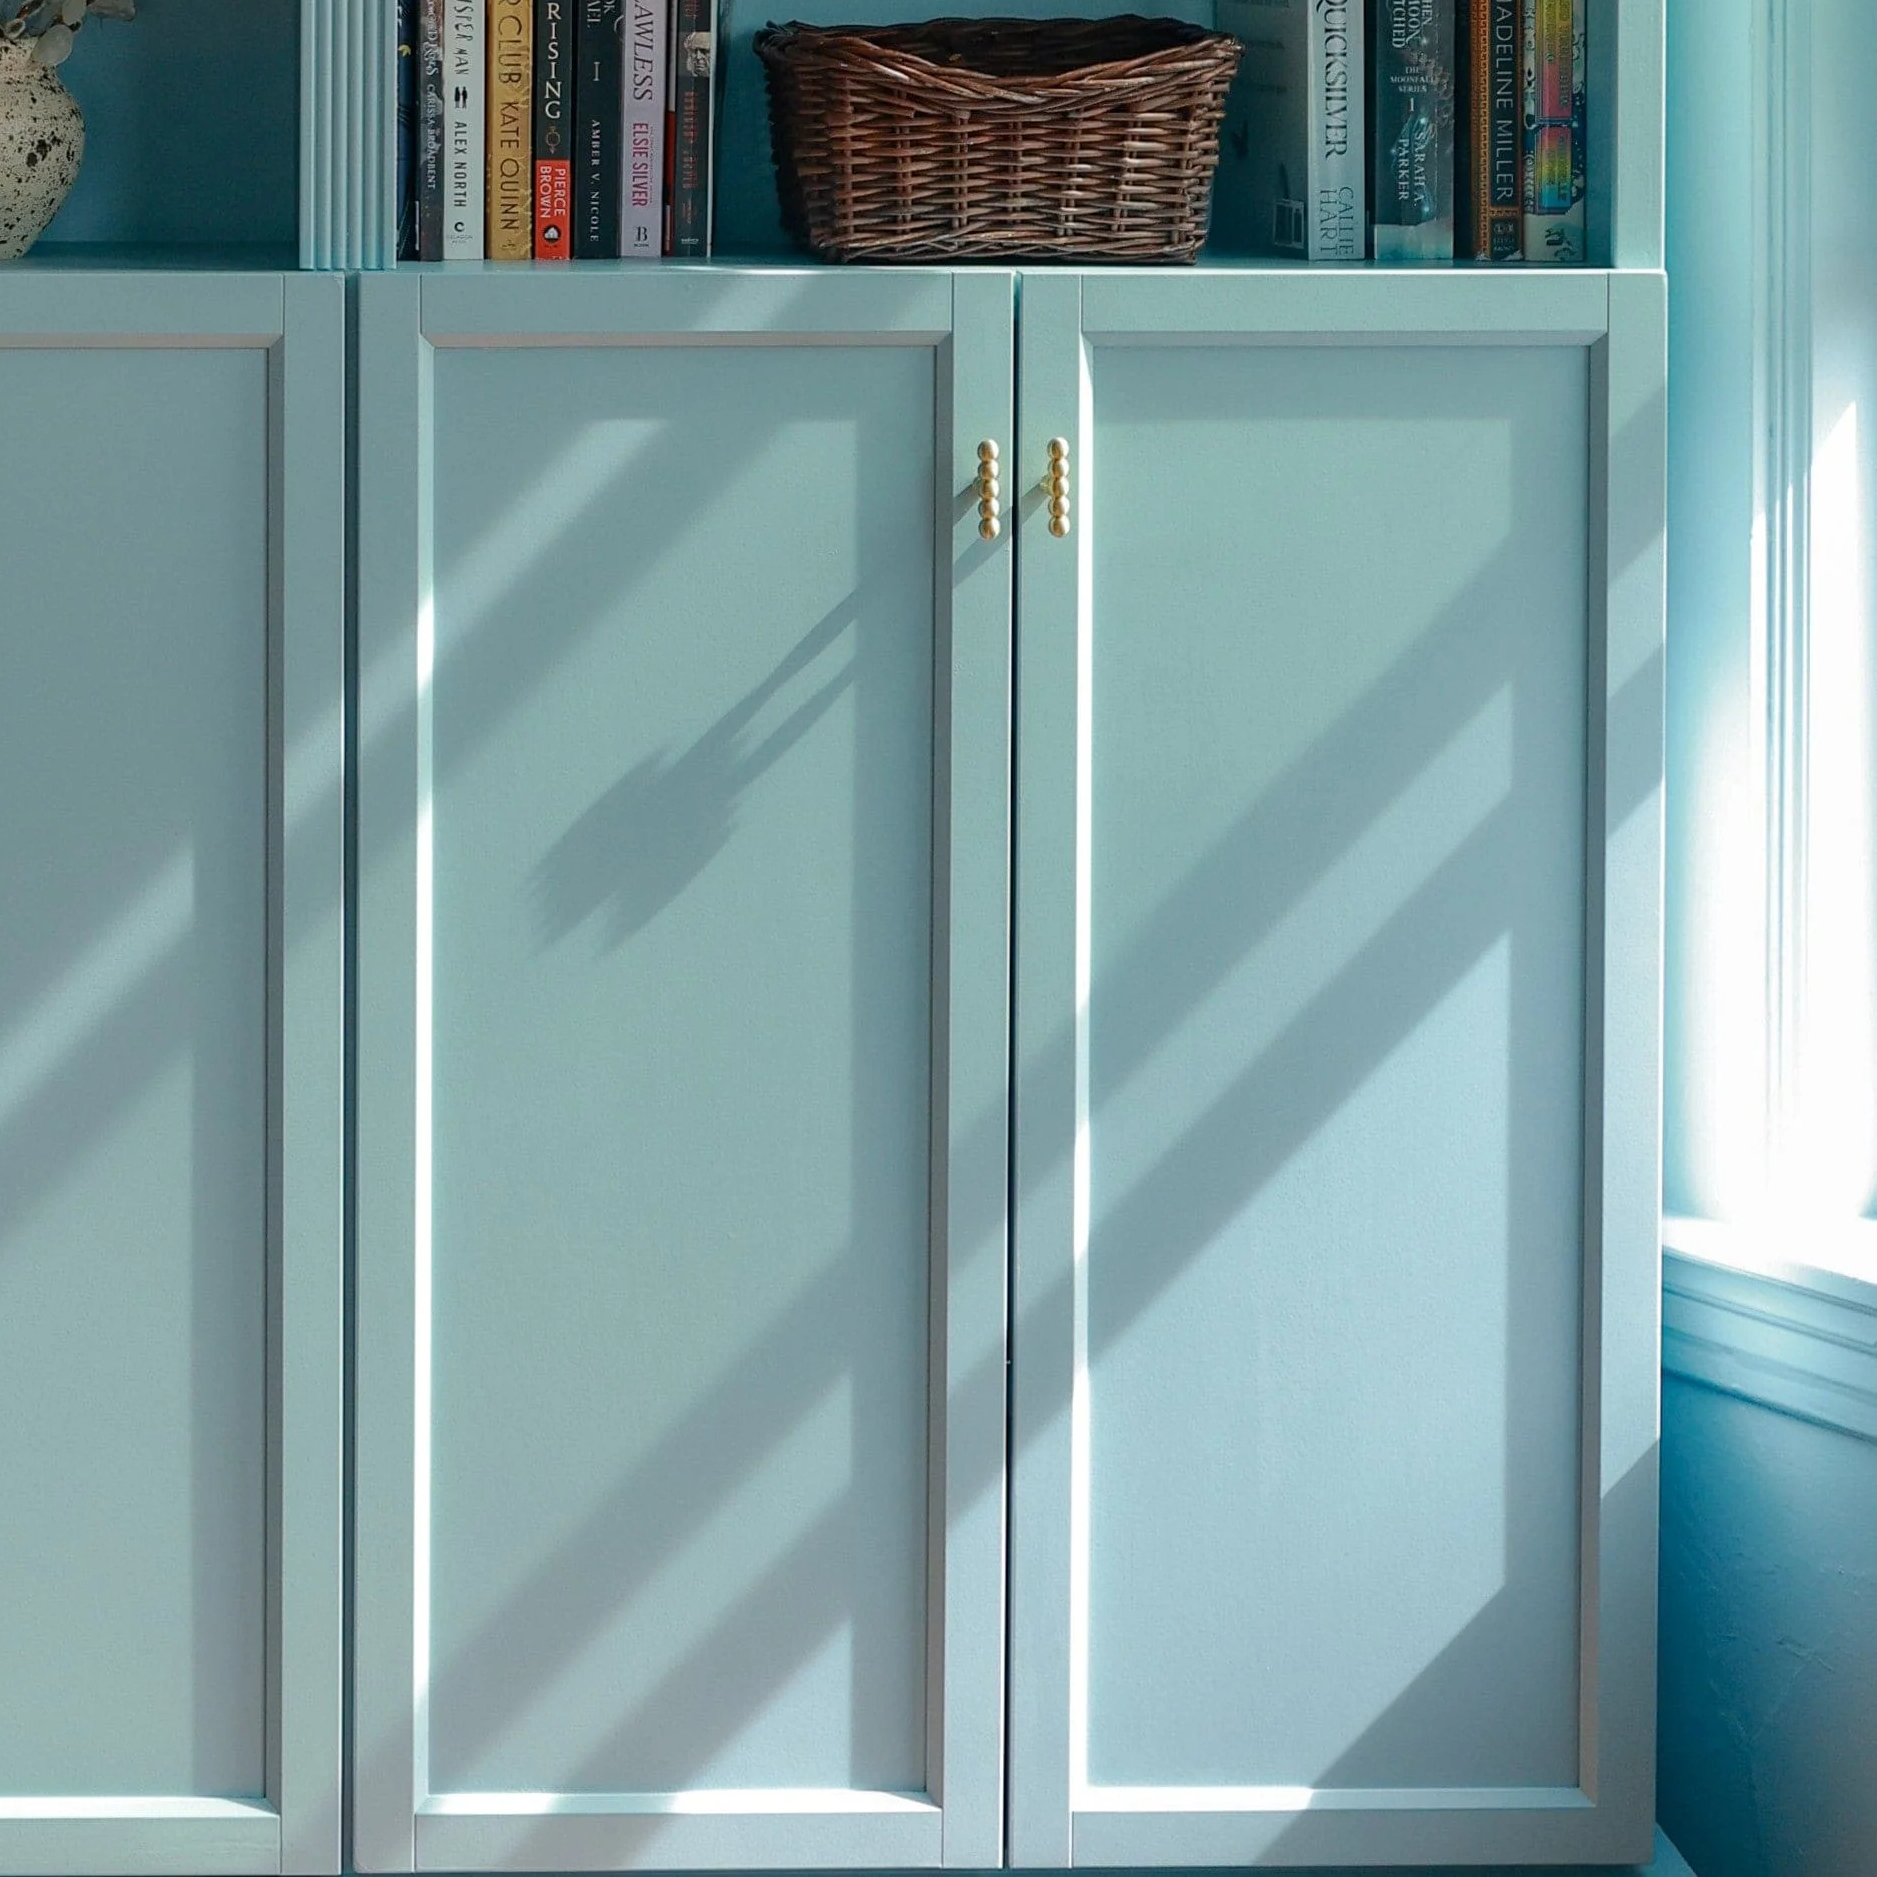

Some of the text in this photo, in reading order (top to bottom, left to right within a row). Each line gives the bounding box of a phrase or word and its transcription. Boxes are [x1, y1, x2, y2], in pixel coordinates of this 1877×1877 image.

[498, 15, 522, 84] CLUB
[1495, 119, 1513, 201] MILLER
[539, 165, 553, 218] BROWN
[553, 168, 567, 216] PIERCE
